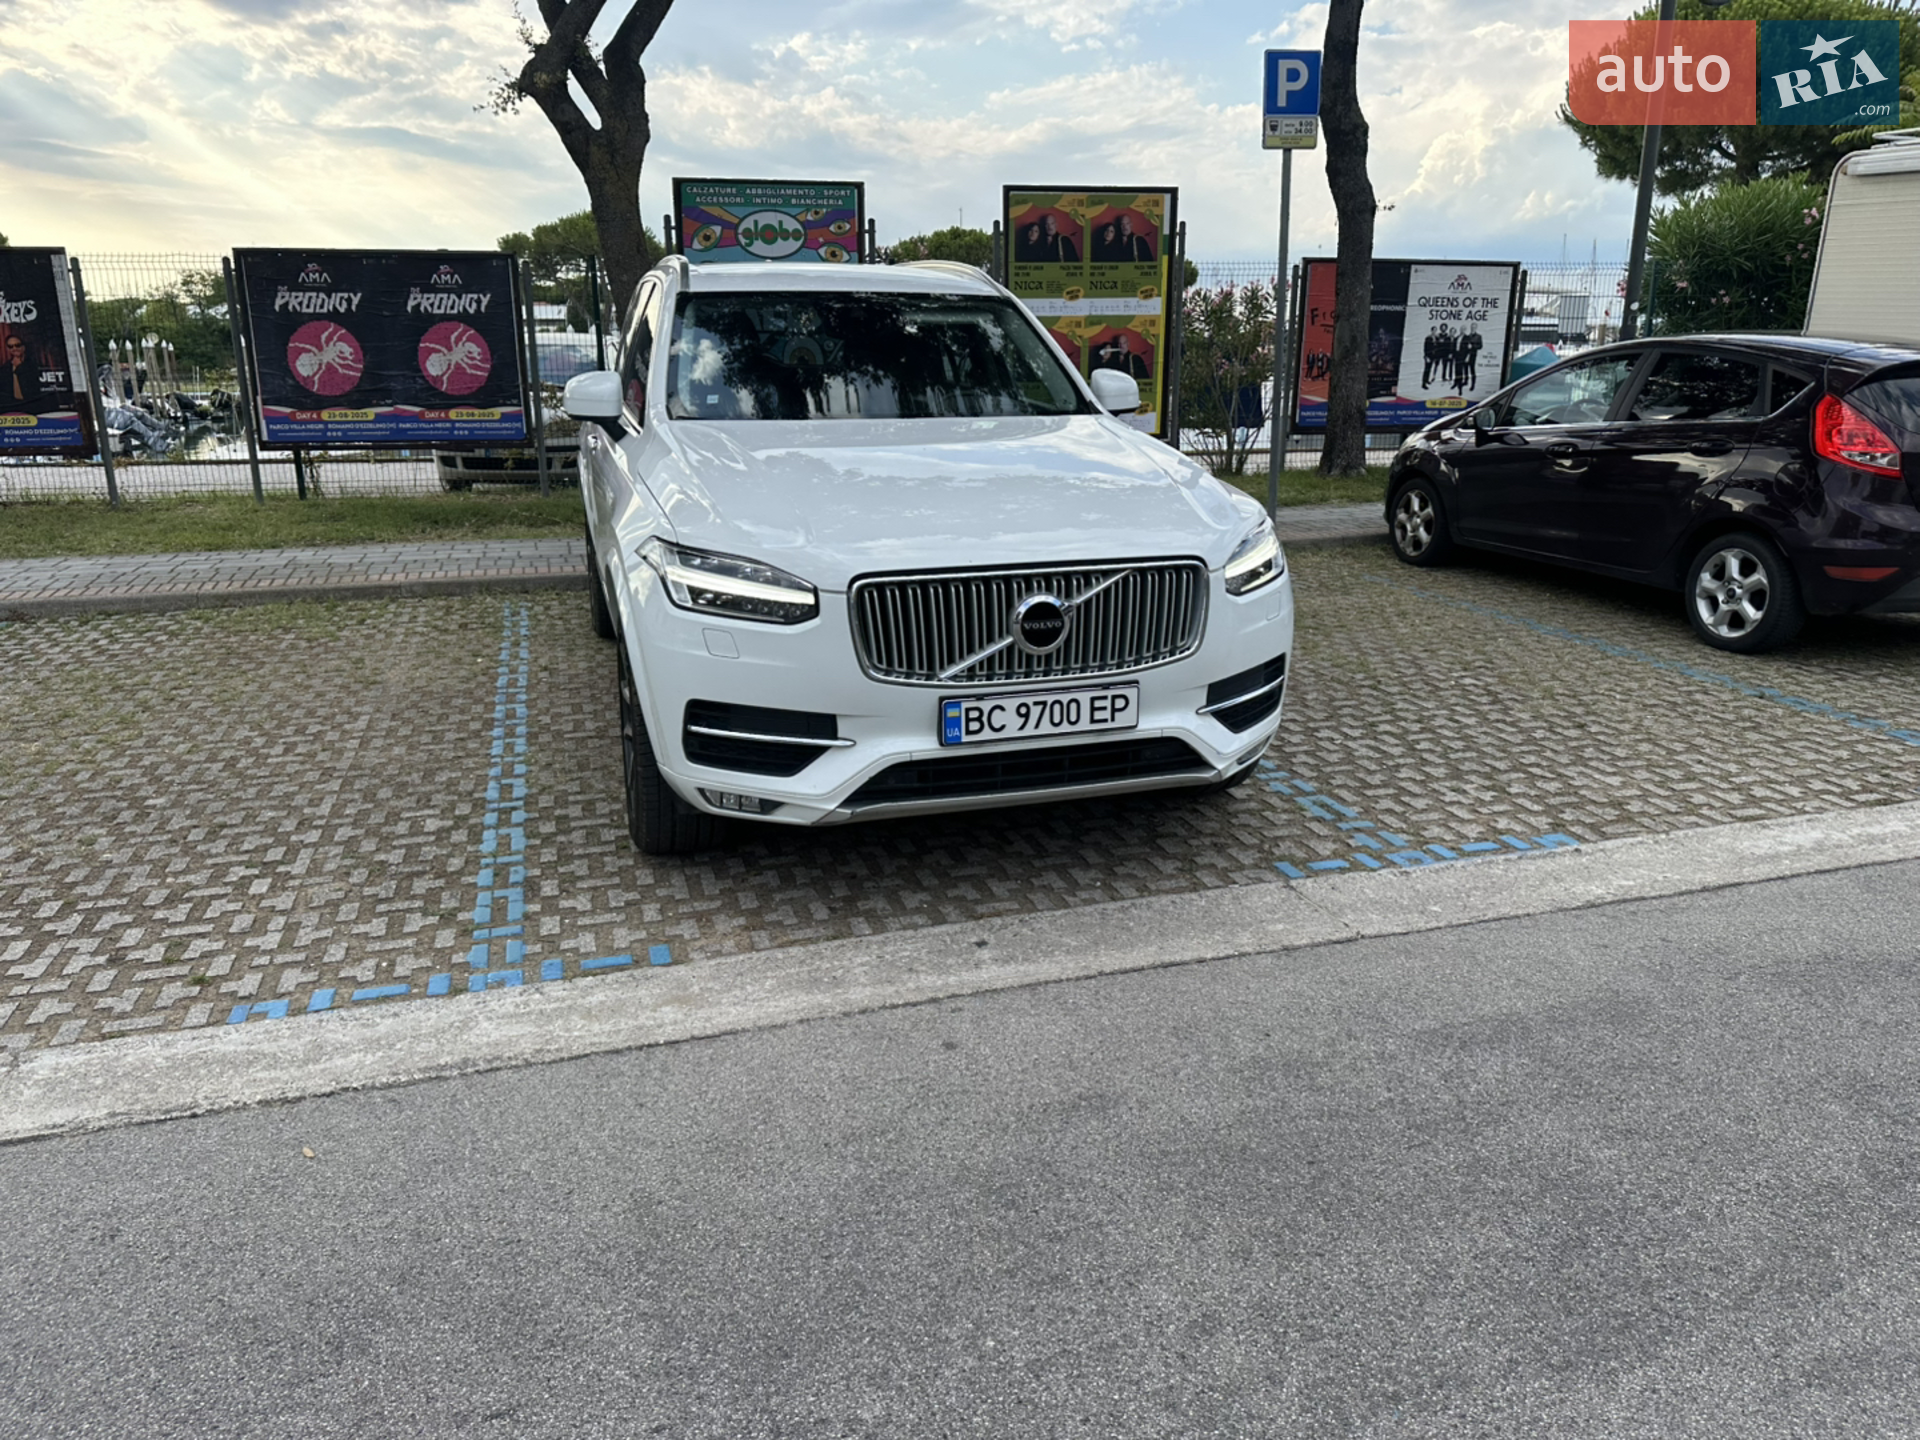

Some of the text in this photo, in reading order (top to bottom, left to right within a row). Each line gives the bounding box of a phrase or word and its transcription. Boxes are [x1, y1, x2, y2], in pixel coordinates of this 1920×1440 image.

[1277, 59, 1309, 107] P
[686, 186, 737, 194] CALZATURE
[745, 187, 816, 196] ABBIGLIAMENTO
[695, 196, 745, 204] ACCESSORI
[791, 198, 844, 206] BIANCHERIA
[741, 219, 804, 247] globo
[274, 291, 362, 313] PRODIGY
[406, 293, 491, 314] PRODIGY
[1417, 296, 1500, 309] QUEENS OF THE
[1428, 309, 1489, 321] STONE AGE
[39, 371, 64, 382] JET
[295, 411, 311, 419] DAY
[311, 411, 317, 419] 4
[424, 411, 440, 419] DAY
[1023, 620, 1063, 630] VOLVO
[964, 694, 1130, 736] BC 9700 EP
[946, 728, 960, 737] UA
